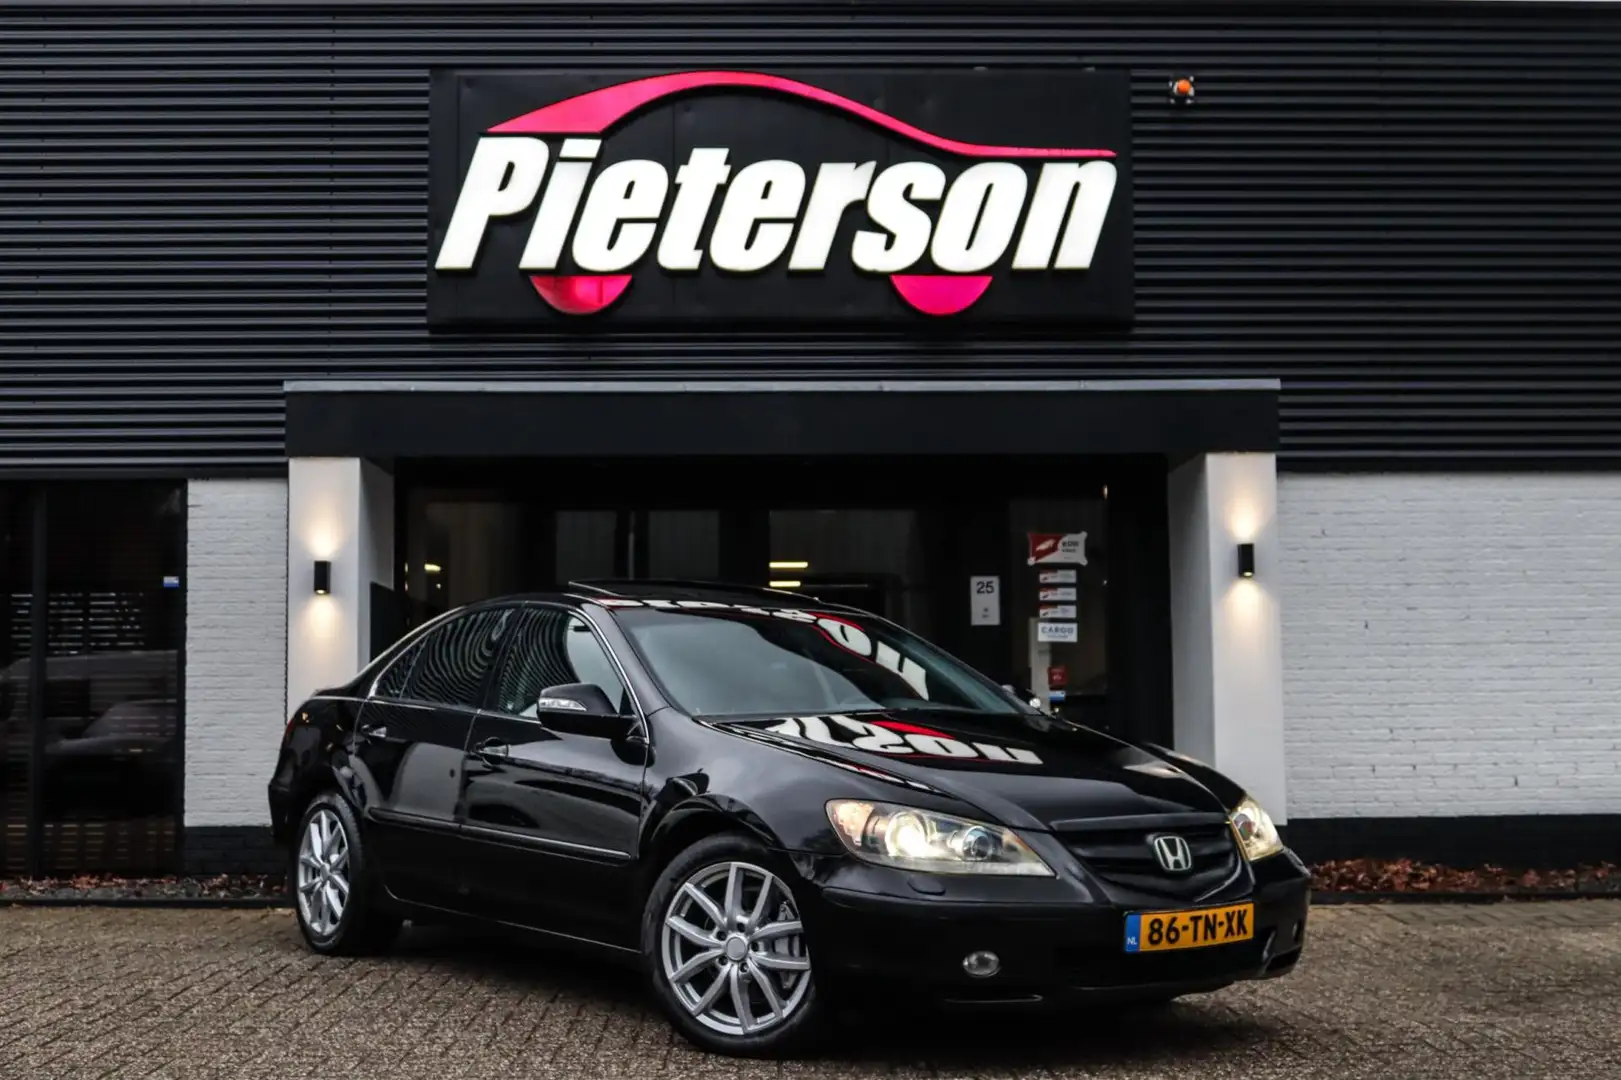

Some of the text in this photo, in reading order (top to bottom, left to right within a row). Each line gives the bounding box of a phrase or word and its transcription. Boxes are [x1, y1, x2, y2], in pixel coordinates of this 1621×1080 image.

[434, 135, 1118, 273] Pieterson
[976, 580, 995, 595] 25
[1147, 908, 1248, 946] 86-TN-XK
[1126, 936, 1138, 946] NL
